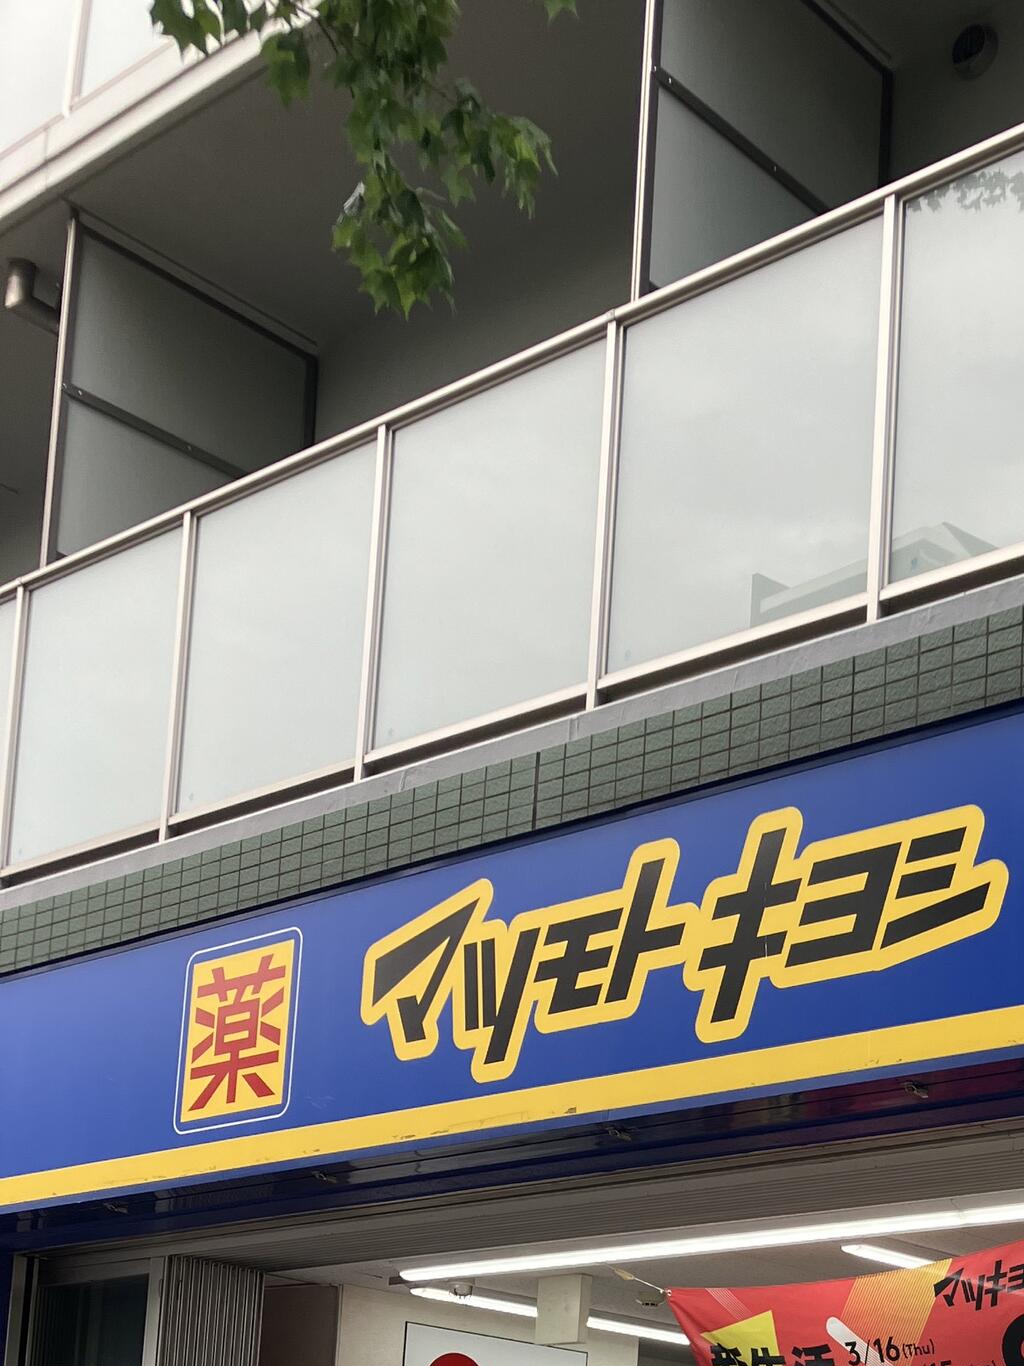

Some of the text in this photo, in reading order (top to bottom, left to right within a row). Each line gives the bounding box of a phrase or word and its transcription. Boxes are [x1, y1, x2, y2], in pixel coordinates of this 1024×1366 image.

[187, 953, 287, 1112] 薬
[366, 814, 1000, 1076] マツモトキヨシ
